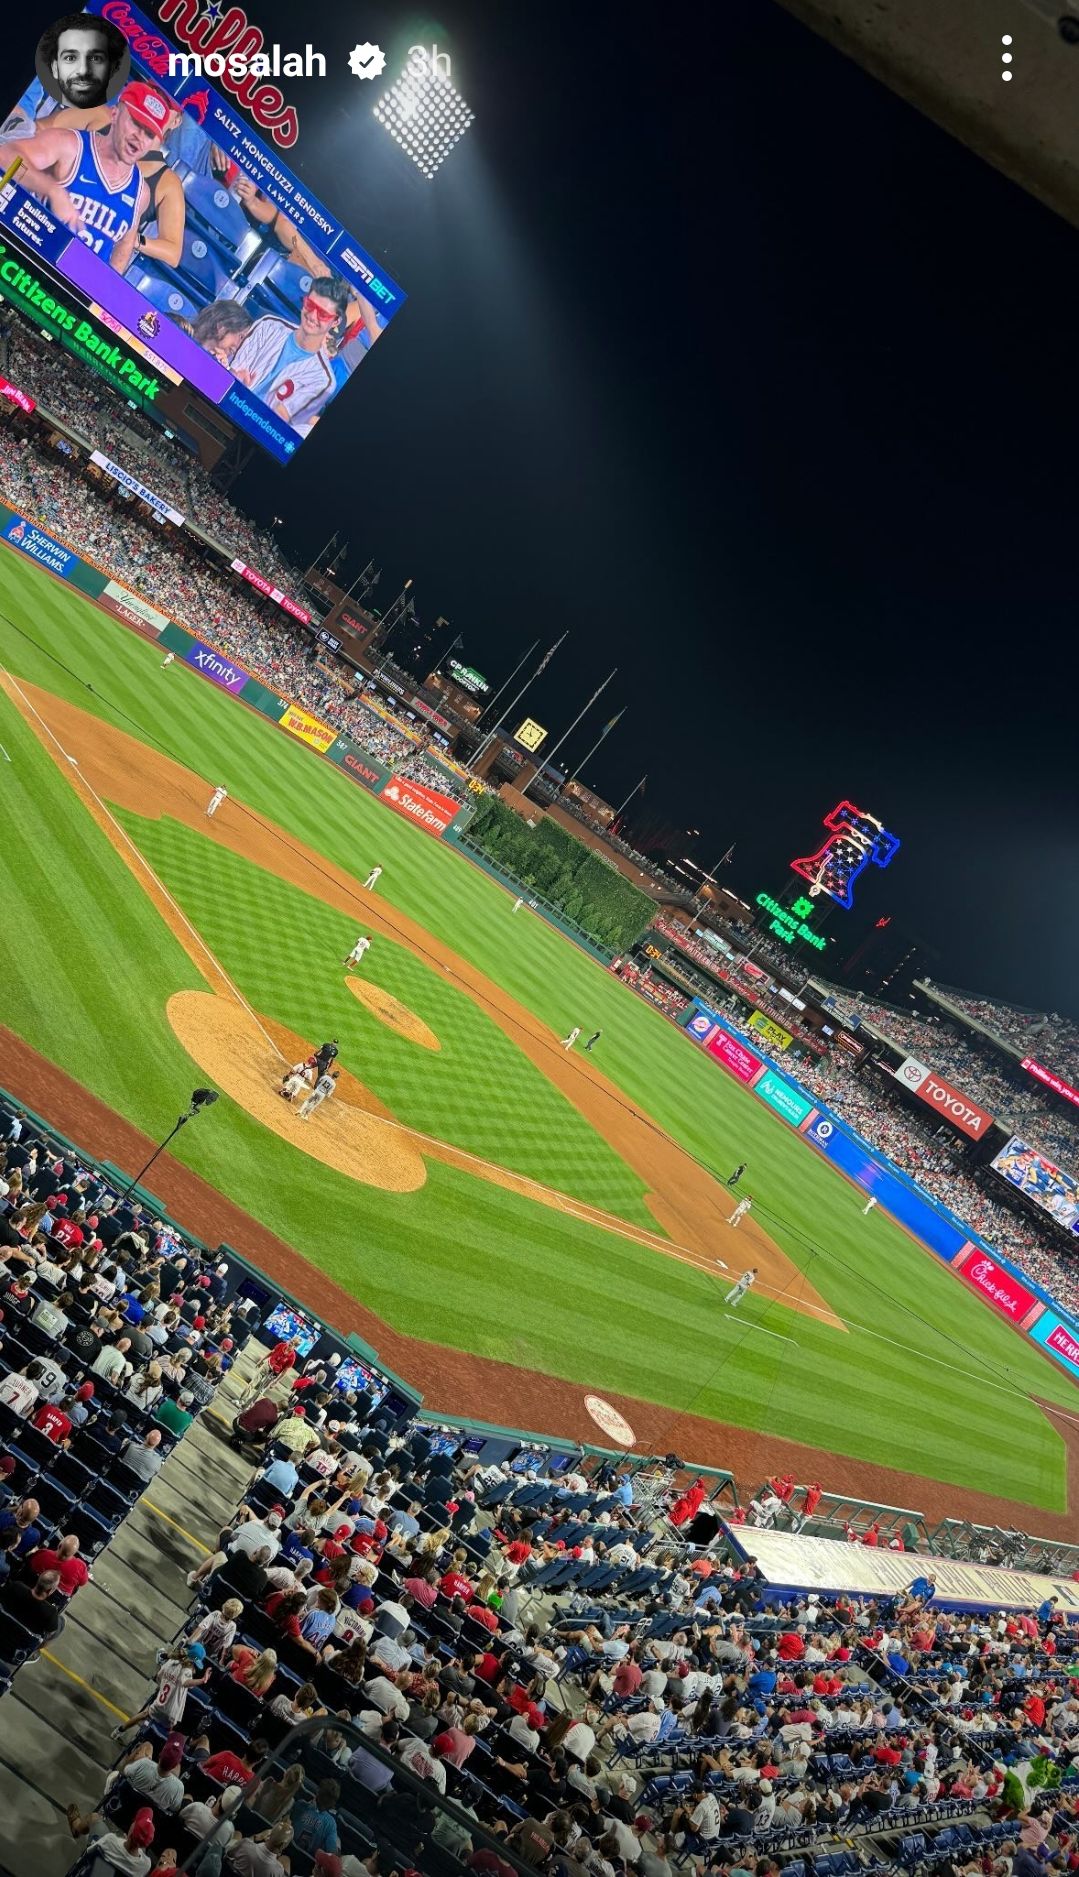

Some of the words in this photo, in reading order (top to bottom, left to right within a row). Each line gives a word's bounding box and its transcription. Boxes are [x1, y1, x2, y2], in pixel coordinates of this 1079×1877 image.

[214, 108, 241, 138] SALTZ
[241, 137, 294, 194] MONGELUZZI
[293, 192, 334, 236] BENDESKY
[230, 146, 264, 180] INJURY
[267, 184, 305, 225] LAWYERS
[17, 207, 41, 232] brave
[23, 199, 56, 234] Building
[340, 248, 375, 285] ESPN
[368, 277, 396, 304] BET
[0, 260, 77, 331] Citizens
[74, 321, 122, 370] Bank
[119, 358, 160, 400] Park
[228, 390, 286, 447] Independence
[105, 461, 140, 492] LISCIO'S
[139, 487, 172, 514] BAKERY
[25, 529, 72, 563] SHERWIN
[244, 568, 273, 593] TOYOTA
[282, 598, 309, 623] TOYOTA
[340, 611, 368, 636] GIANT
[194, 650, 241, 686] xfinity
[343, 753, 380, 784] GIANT
[755, 892, 799, 930] Citizens
[797, 921, 827, 950] Bank
[769, 920, 796, 944] Park
[724, 1040, 737, 1051] Fox
[766, 1025, 787, 1042] PLAY
[772, 1088, 804, 1115] NEMOURS
[924, 1080, 983, 1131] TOYOTA
[970, 1262, 1018, 1313] Chick-fil-A
[11, 1391, 21, 1407] 7
[290, 1547, 306, 1561] HARPE
